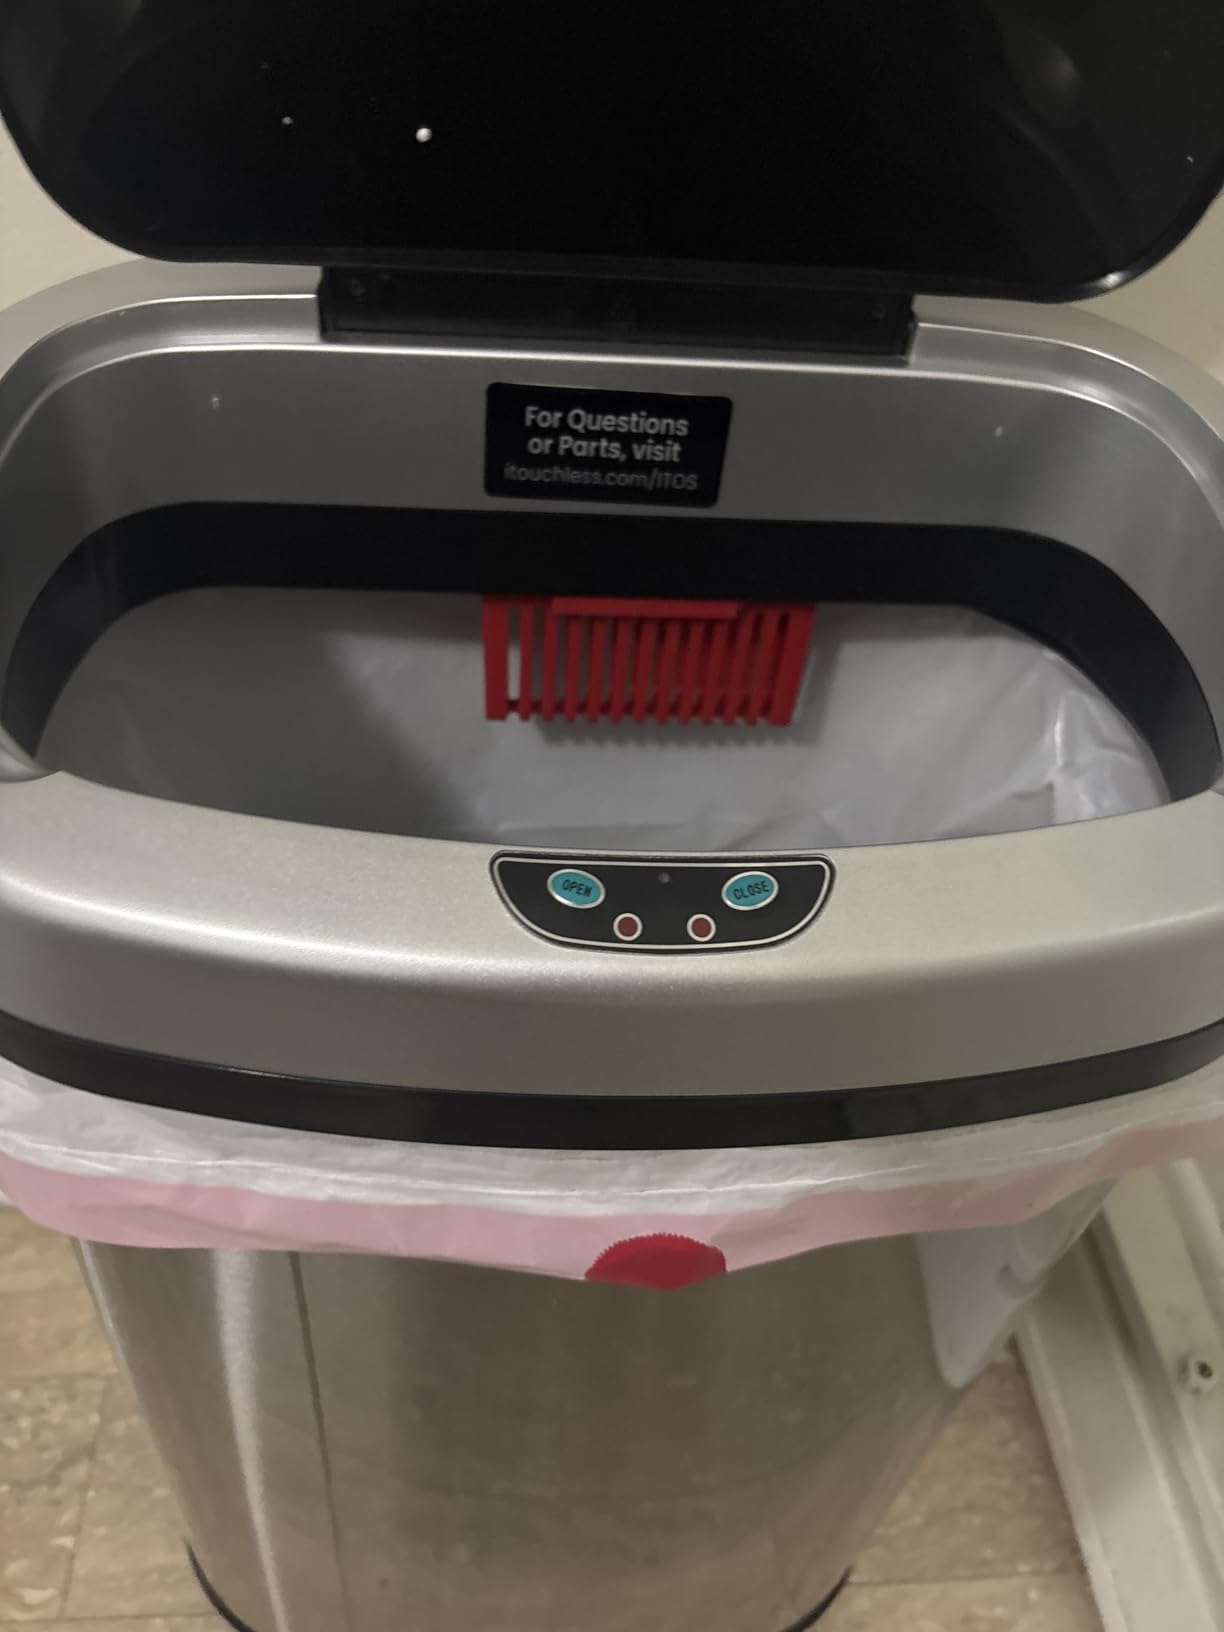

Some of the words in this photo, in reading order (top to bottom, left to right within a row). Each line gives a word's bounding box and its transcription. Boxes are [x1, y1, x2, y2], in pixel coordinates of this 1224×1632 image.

[524, 405, 562, 428] For
[567, 408, 689, 436] Questions
[527, 437, 554, 454] or
[557, 435, 627, 462] Parts,
[632, 439, 682, 462] visit
[561, 879, 592, 897] OPEN
[733, 881, 769, 900] CLOSE
